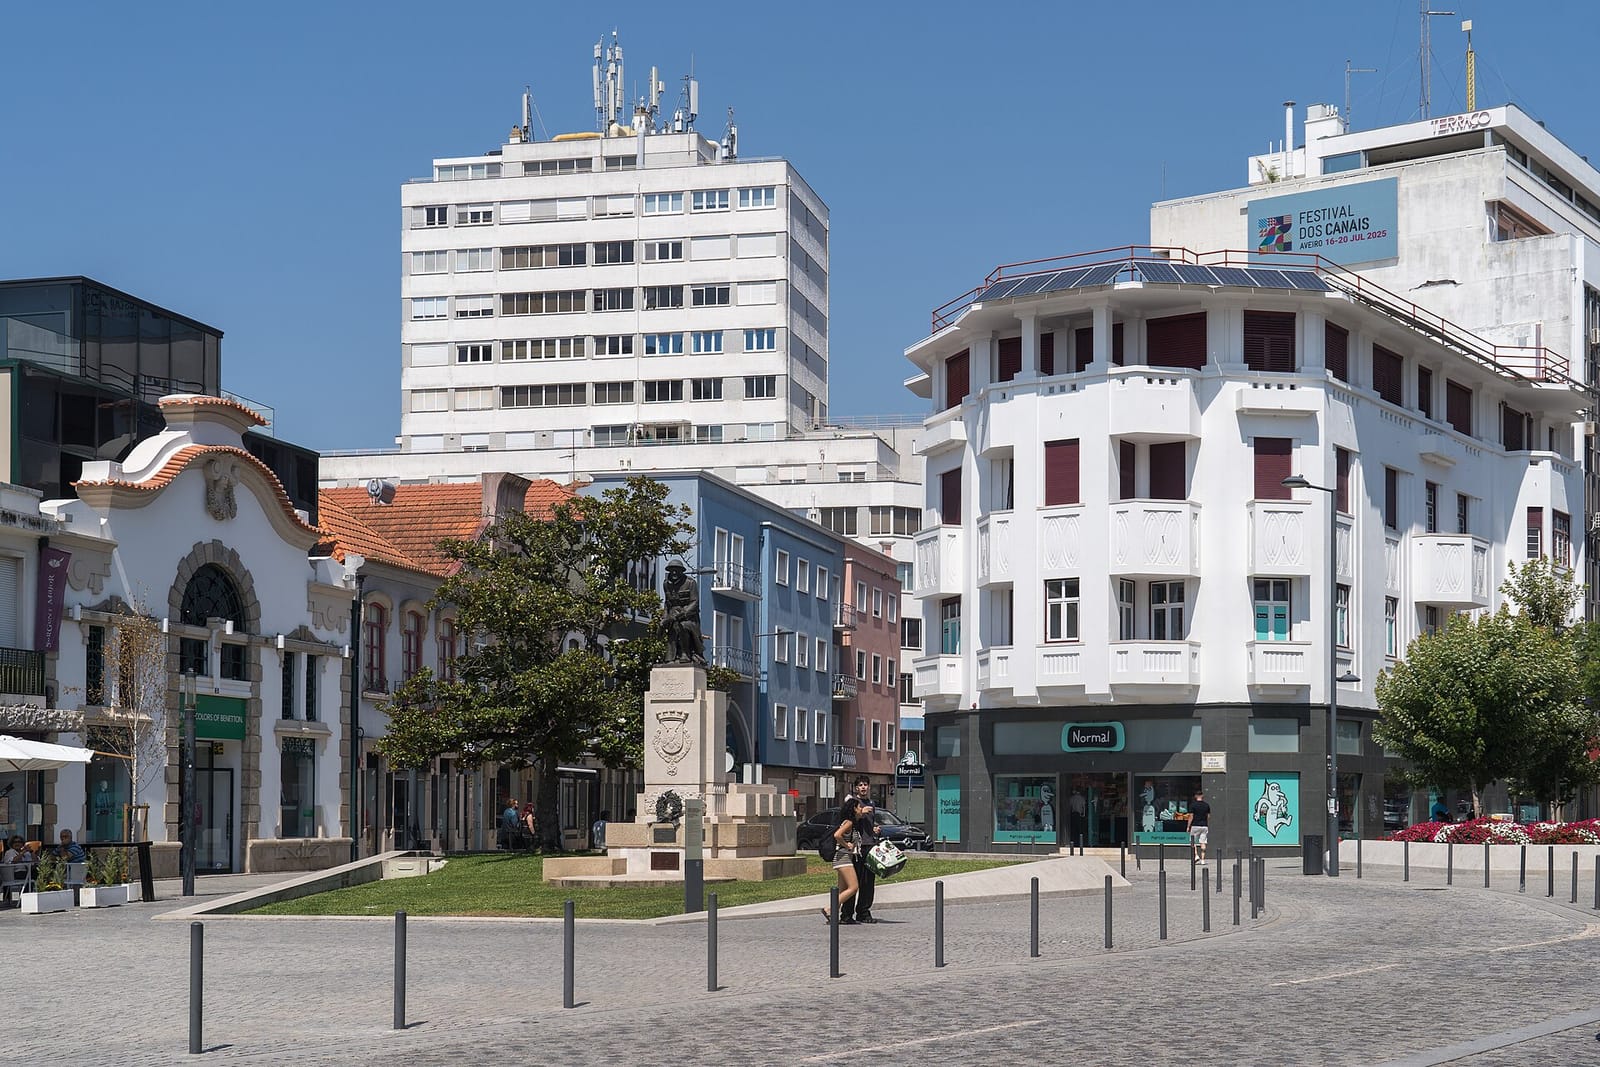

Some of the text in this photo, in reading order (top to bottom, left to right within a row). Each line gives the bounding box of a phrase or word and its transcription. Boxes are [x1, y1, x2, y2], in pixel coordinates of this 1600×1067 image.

[1299, 204, 1355, 225] FESTIVAL
[1299, 217, 1370, 240] DOS CANAIS
[1299, 229, 1388, 250] AVEIRO 16-20 JUL 2025
[213, 713, 219, 722] OF
[1072, 729, 1110, 743] Normal
[898, 766, 921, 775] Normal
